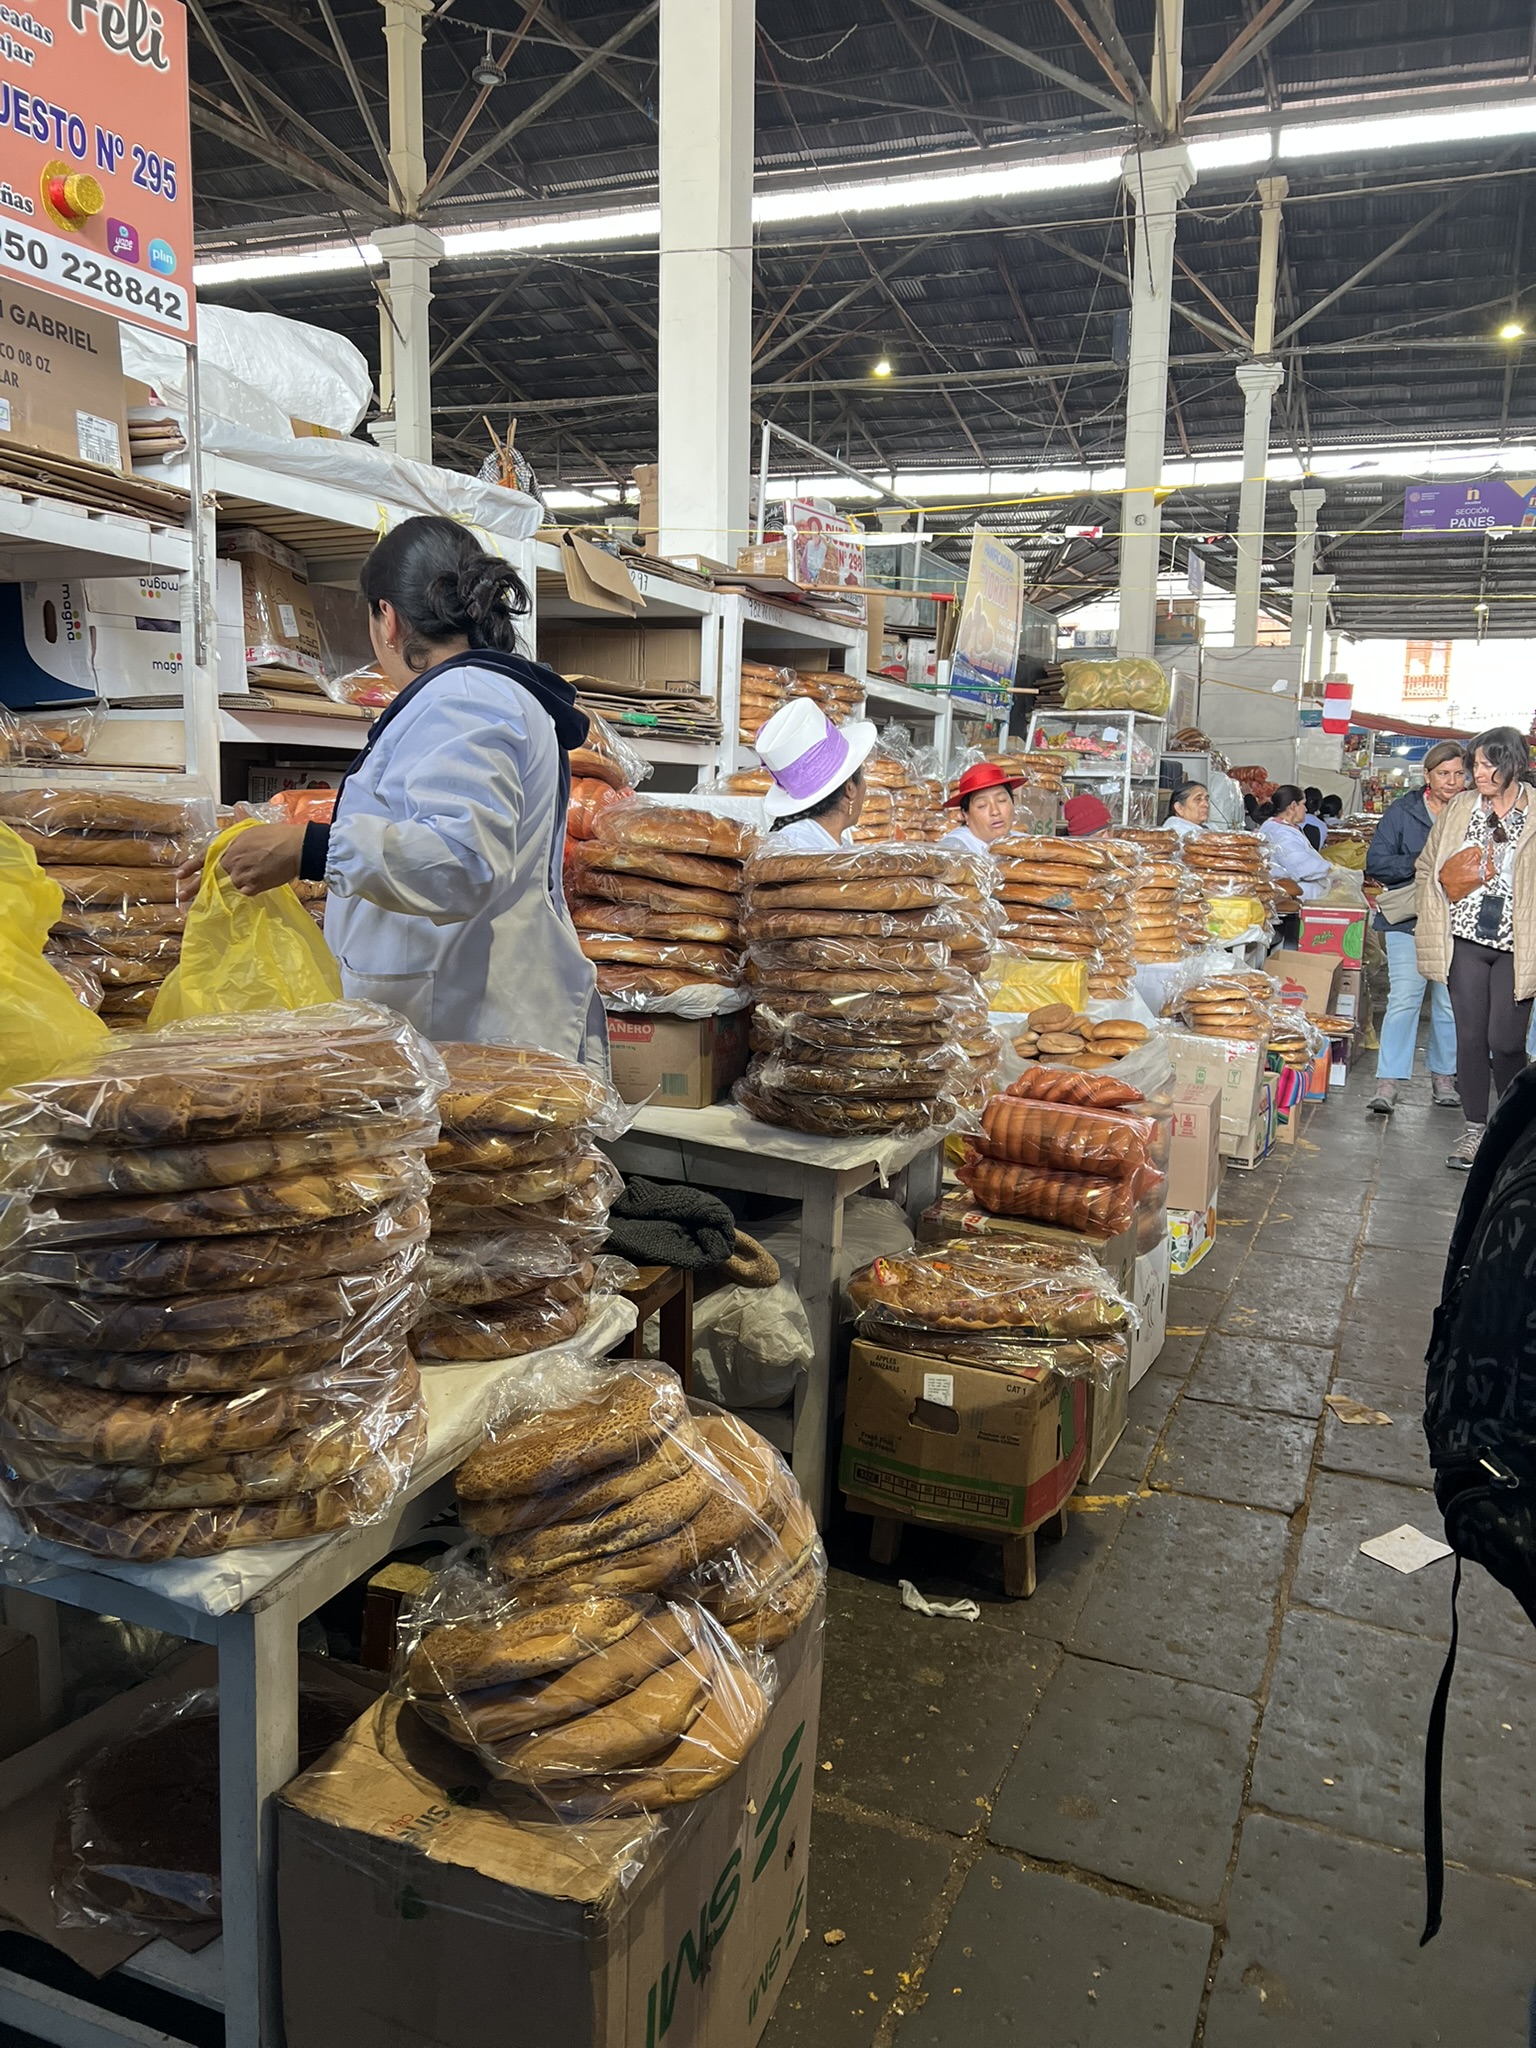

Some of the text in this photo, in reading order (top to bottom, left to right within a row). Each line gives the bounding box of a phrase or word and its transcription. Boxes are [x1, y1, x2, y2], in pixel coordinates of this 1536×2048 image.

[133, 145, 177, 201] 295
[152, 249, 173, 265] plin
[62, 252, 183, 321] 228842
[9, 303, 98, 354] GABRIEL
[18, 349, 32, 367] 08
[36, 355, 51, 374] OZ
[1455, 506, 1490, 516] SECCIÓN
[1450, 515, 1496, 529] PANES
[608, 1023, 652, 1035] ANERO
[870, 1360, 900, 1373] MANZANAS
[875, 1354, 897, 1365] APPLES
[1006, 1384, 1027, 1396] CAT 1
